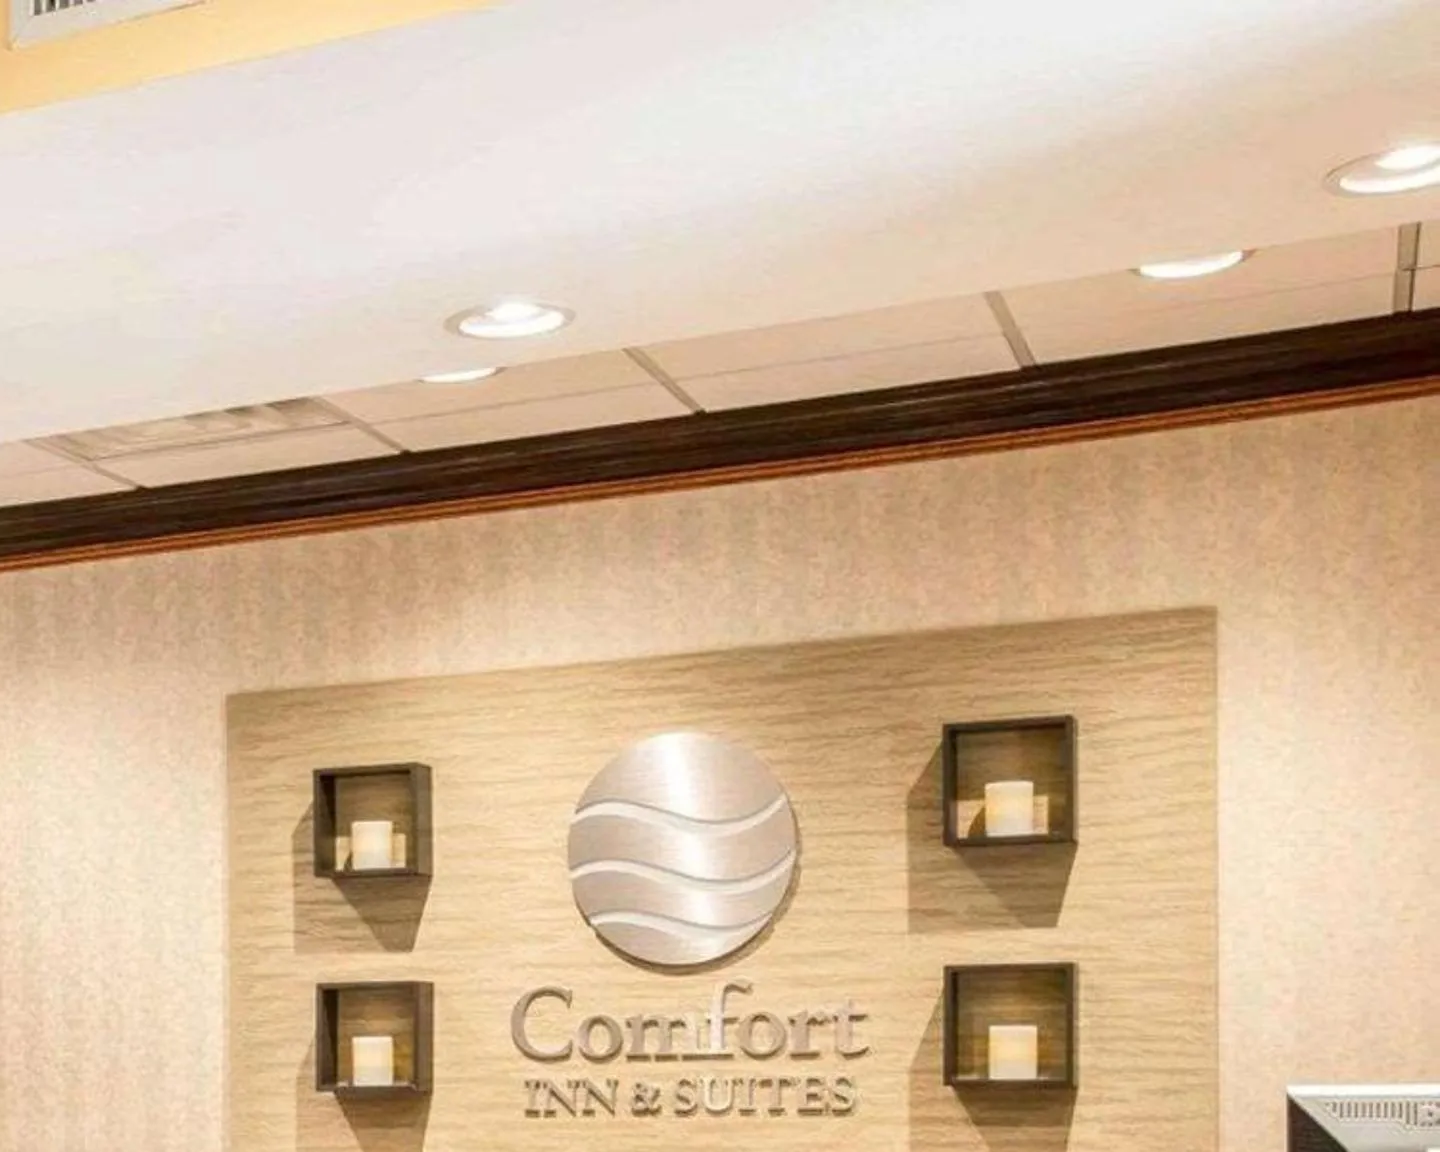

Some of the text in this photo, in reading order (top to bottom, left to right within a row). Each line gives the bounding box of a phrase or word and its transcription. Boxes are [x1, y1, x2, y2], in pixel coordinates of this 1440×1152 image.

[510, 980, 872, 1064] Comfort
[524, 1076, 859, 1119] INN & SUITES
